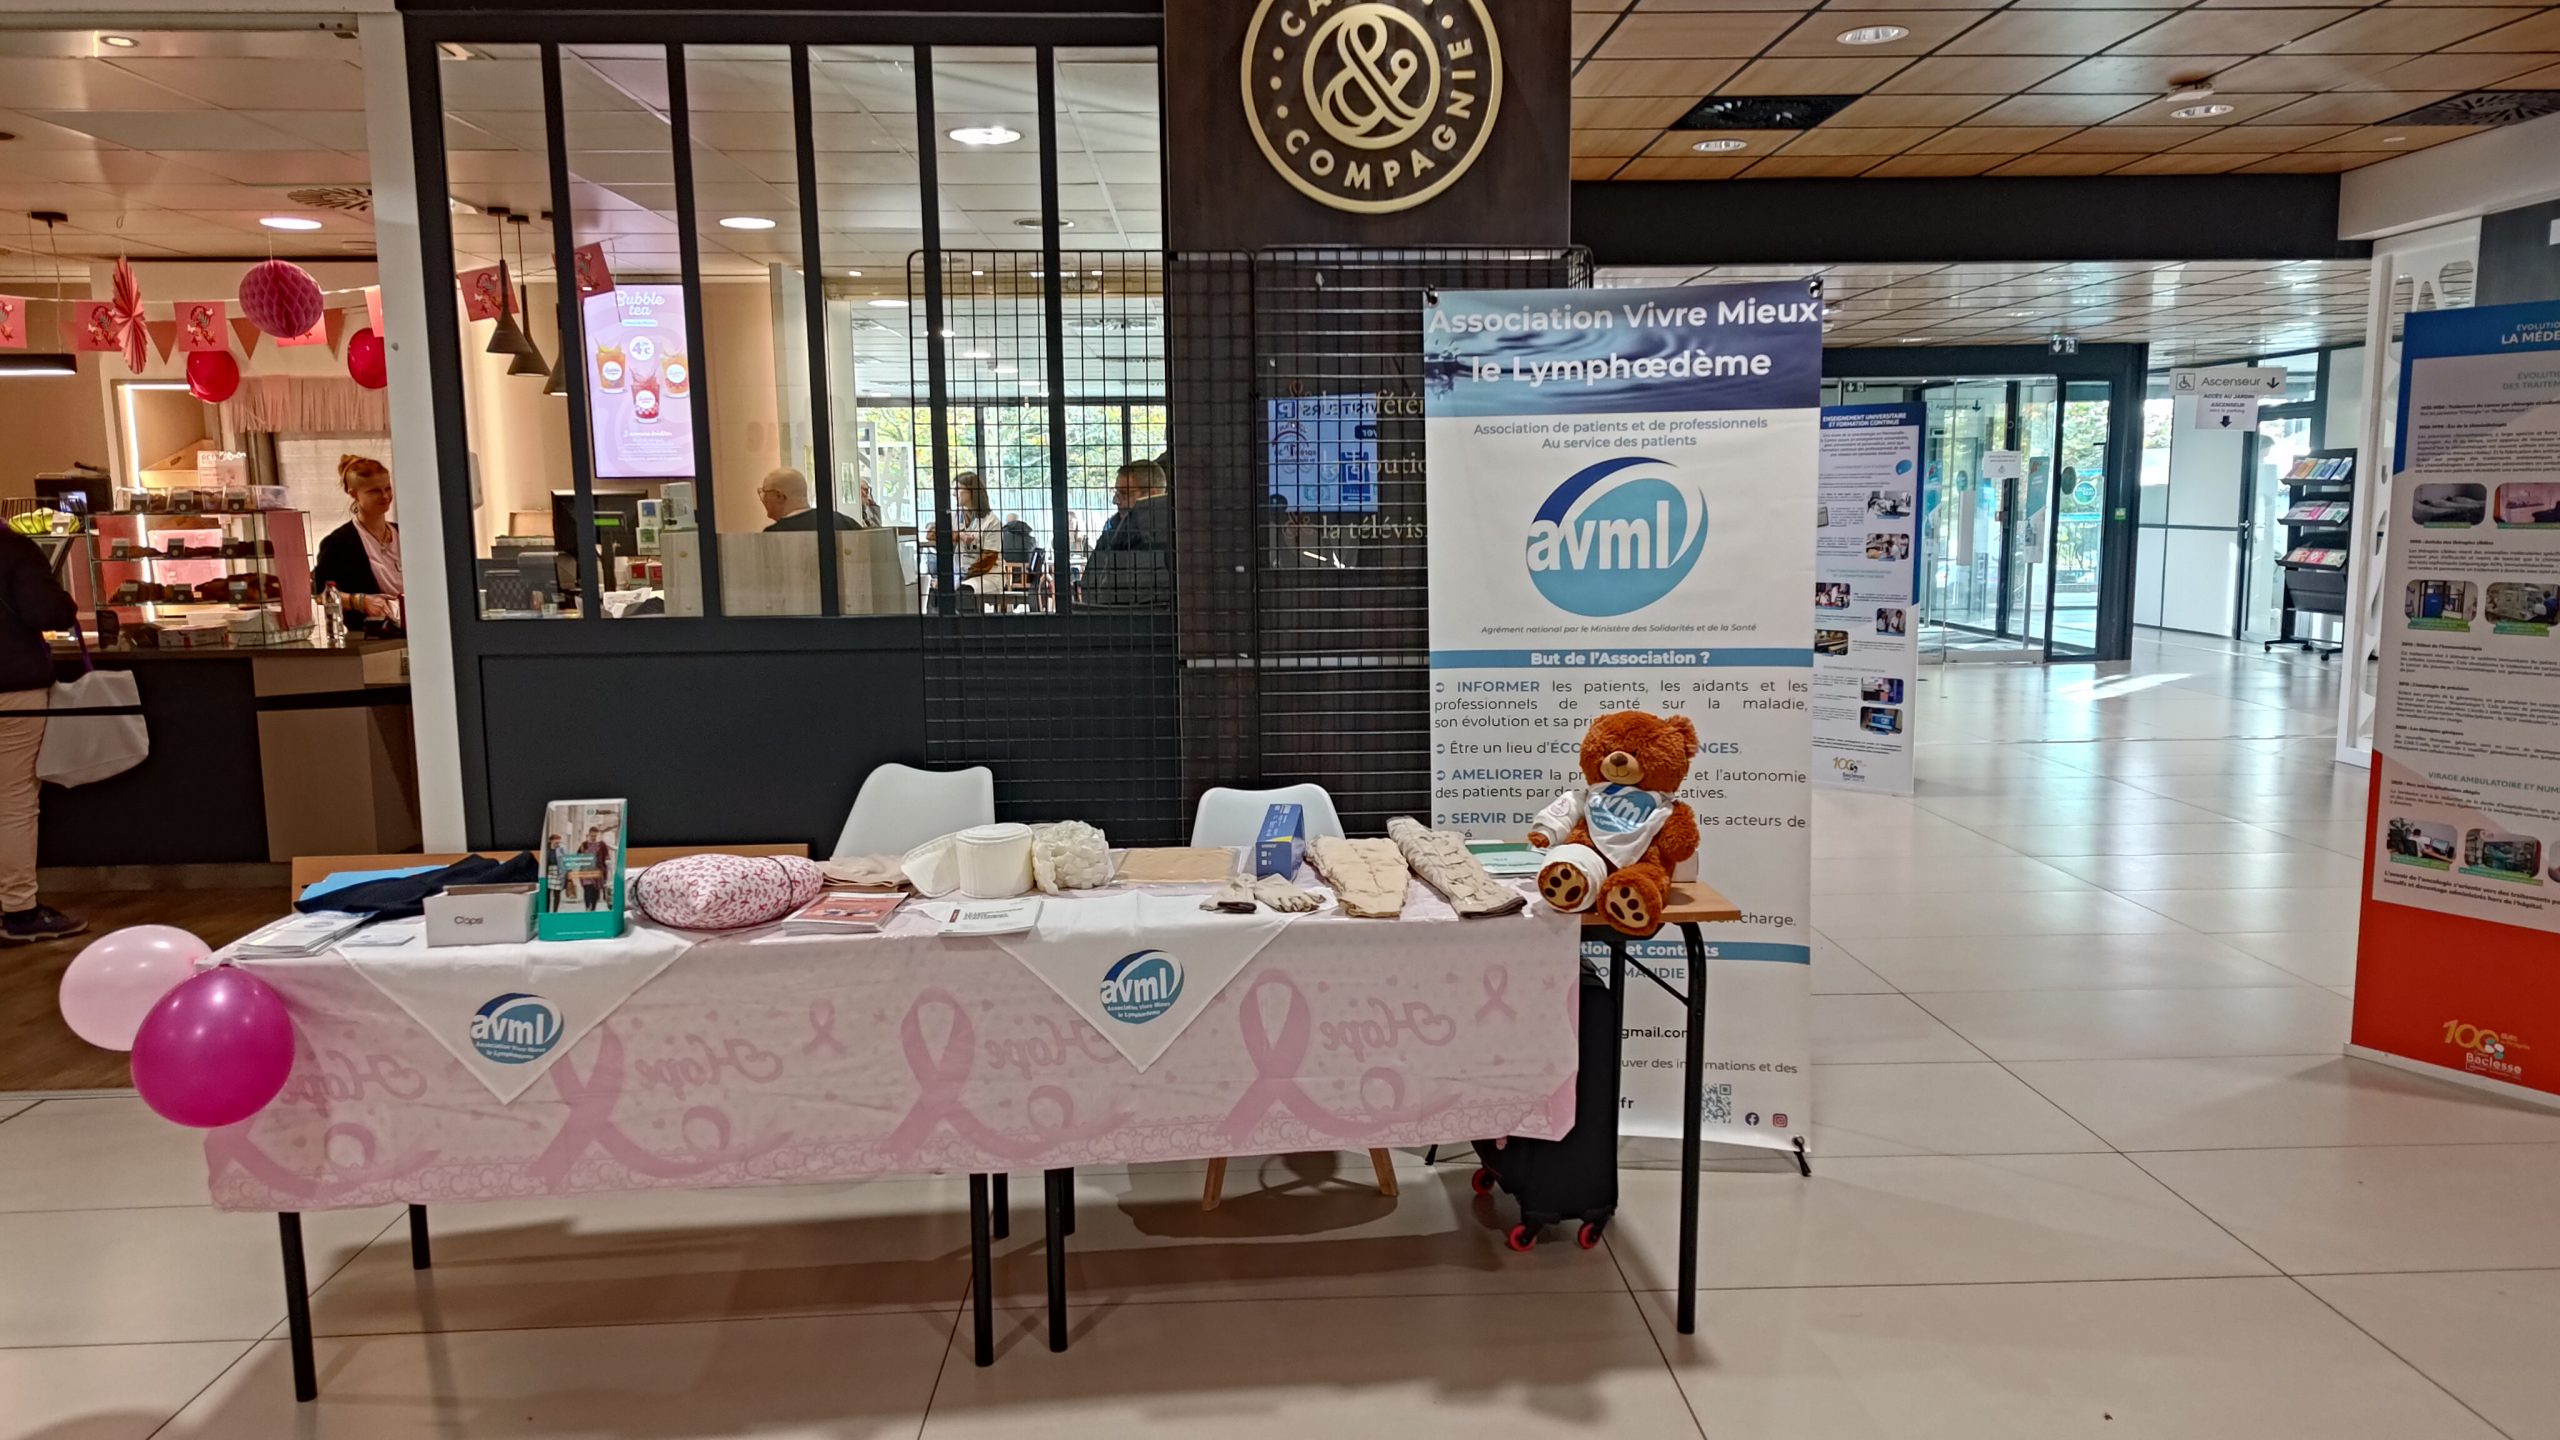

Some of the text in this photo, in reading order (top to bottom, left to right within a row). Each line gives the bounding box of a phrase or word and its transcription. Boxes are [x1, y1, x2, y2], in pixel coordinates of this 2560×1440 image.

[1286, 38, 1476, 190] COMPAGNIE
[614, 290, 665, 307] Bubble
[629, 306, 652, 316] tea
[1428, 297, 1819, 333] Association Vivre Mieux
[2501, 330, 2560, 345] LA MÉDE
[1472, 349, 1772, 388] le Lymphœdème
[2201, 377, 2261, 386] Ascenseur
[2523, 380, 2560, 389] TRAITEM
[1474, 416, 1768, 436] Association de patients et de professionnels
[1542, 434, 1697, 449] Au service des patients
[1321, 514, 1426, 540] la télévis
[1527, 500, 1669, 572] avml
[1481, 623, 1757, 635] Agrément national par le Ministère des Solidarités et de la Santé
[1531, 650, 1710, 665] But de l'Association ?
[1457, 680, 1808, 694] INFORMER les patients, les aidants et les
[1434, 697, 1808, 713] professionnels de santé sur la maladie,
[1434, 714, 1593, 729] son évolution et sa pri
[1450, 741, 1479, 754] Être
[1483, 744, 1501, 754] un
[1506, 742, 1532, 754] lieu
[1536, 740, 1581, 754] d'ÉCO
[1452, 769, 1543, 780] AMELIORER
[1550, 769, 1562, 780] la
[1694, 771, 1709, 781] et
[1716, 769, 1807, 783] l'autonomie
[2428, 771, 2458, 782] VIRAGE
[2460, 776, 2522, 790] AMBULATOIRE
[2536, 785, 2560, 793] NUM
[1435, 787, 1459, 799] des
[1463, 786, 1522, 799] patients
[1526, 787, 1550, 799] par
[1452, 812, 1506, 824] SERVIR
[1700, 814, 1720, 825] les
[1725, 815, 1782, 827] acteurs
[1787, 816, 1806, 828] de
[1740, 912, 1797, 928] charge.
[1626, 942, 1643, 956] et
[1101, 967, 1168, 1004] avml
[471, 1013, 544, 1045] avml
[2442, 1019, 2500, 1053] 100
[1652, 1058, 1673, 1069] des
[1759, 1063, 1771, 1073] et
[1775, 1063, 1798, 1074] des
[2466, 1052, 2522, 1074] Baclesse
